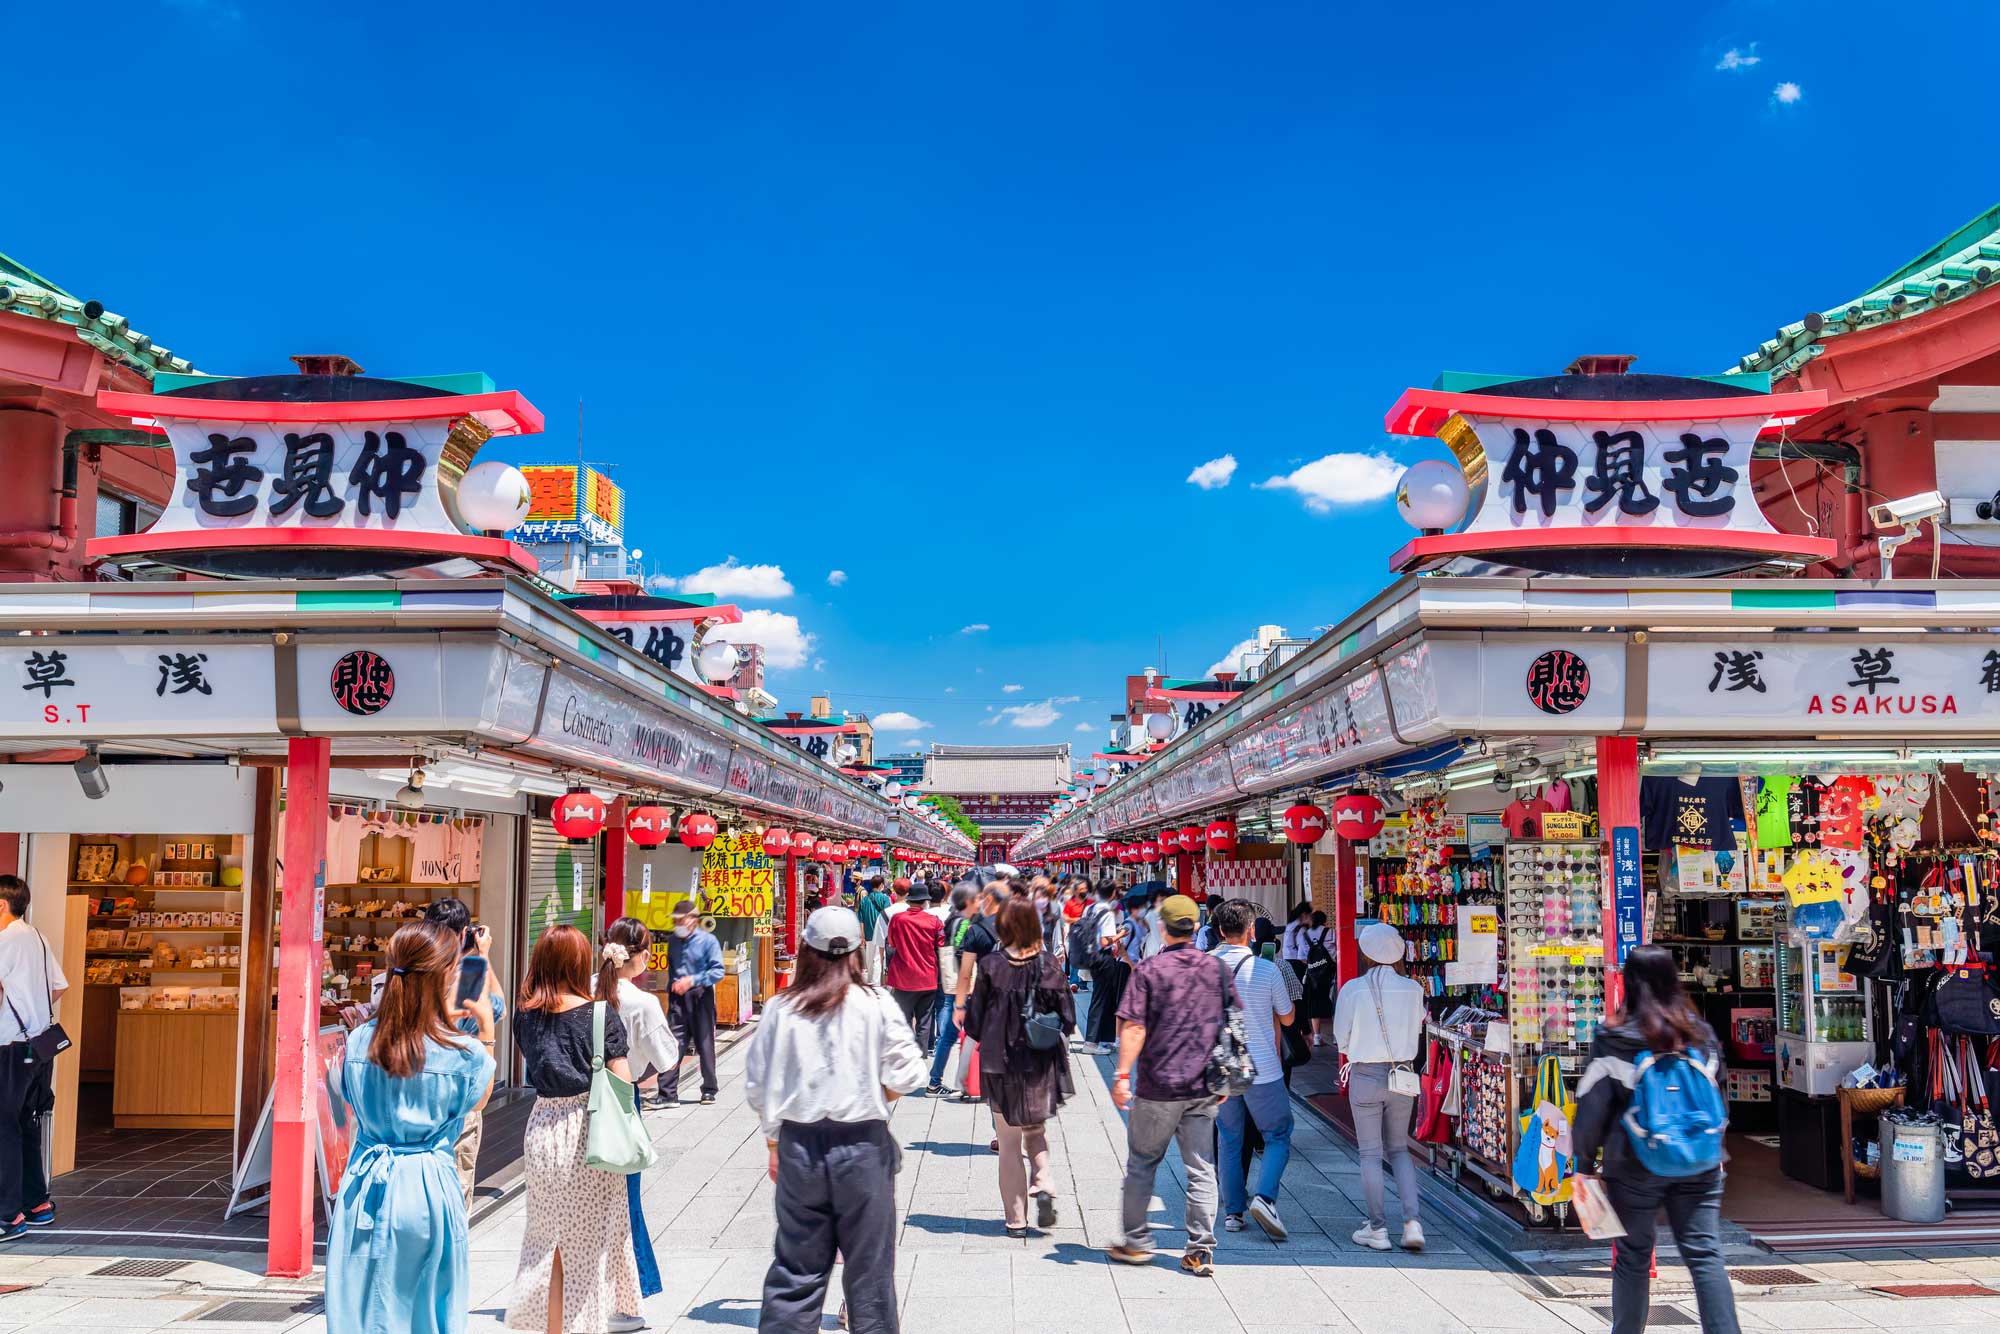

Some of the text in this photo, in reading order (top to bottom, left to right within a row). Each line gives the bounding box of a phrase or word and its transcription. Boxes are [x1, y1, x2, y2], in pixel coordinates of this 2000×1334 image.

[562, 696, 614, 747] Cosmetics
[631, 724, 682, 767] MONKADO
[1807, 695, 1957, 714] ASAKUSA
[1622, 860, 1635, 934] 浅草一丁目
